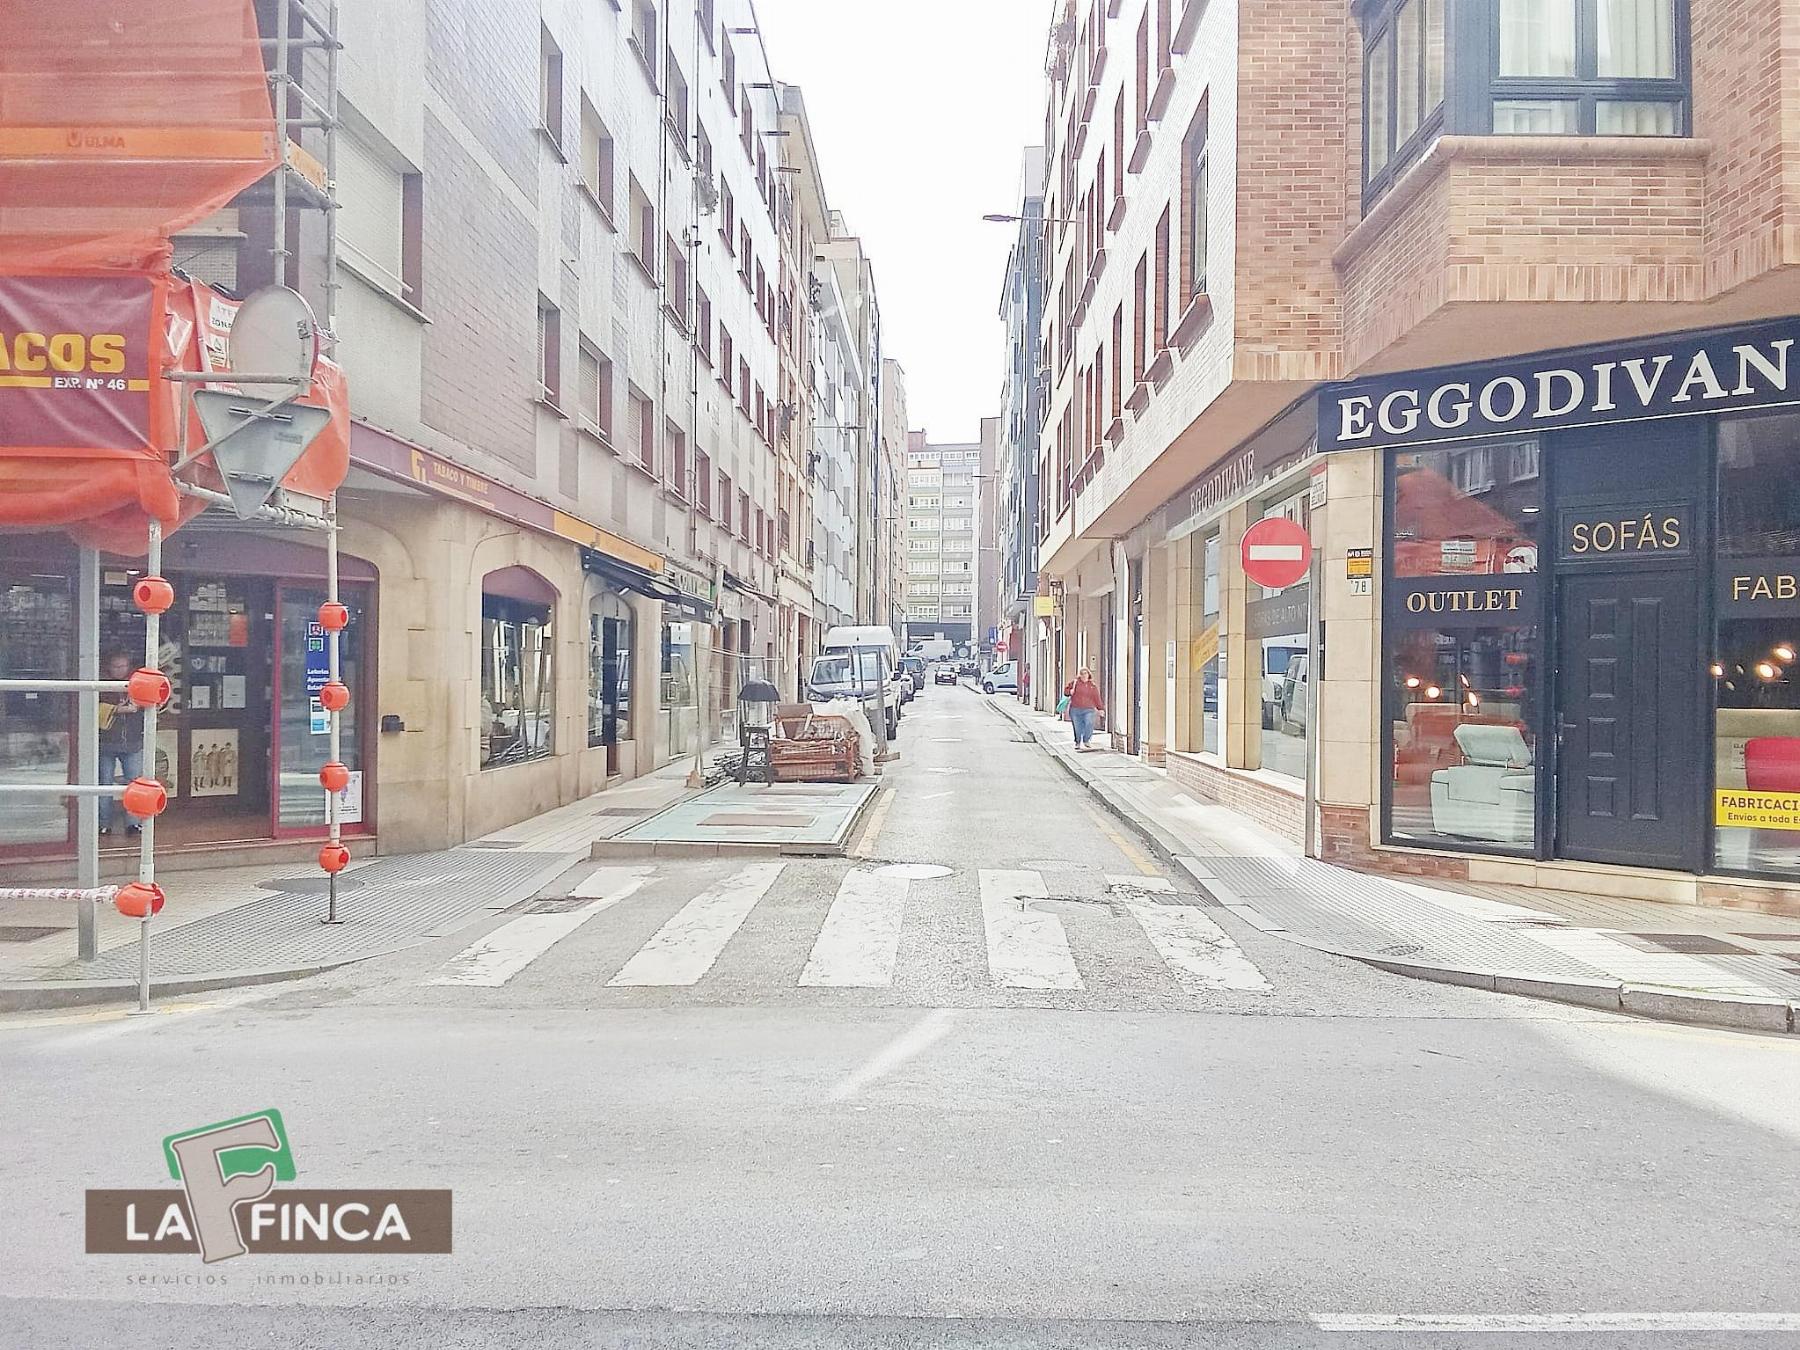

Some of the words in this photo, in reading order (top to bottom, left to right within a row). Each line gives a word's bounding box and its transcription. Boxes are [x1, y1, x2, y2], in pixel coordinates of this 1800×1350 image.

[54, 377, 82, 389] EXP.
[107, 379, 126, 391] 46
[1337, 339, 1794, 442] EGGODIVAN
[1572, 512, 1681, 553] SOFÁS
[1731, 574, 1798, 601] FAB
[1406, 589, 1523, 613] OUTLET
[1721, 796, 1799, 811] FABRICACI
[1769, 815, 1790, 824] toda
[1793, 816, 1800, 824] E
